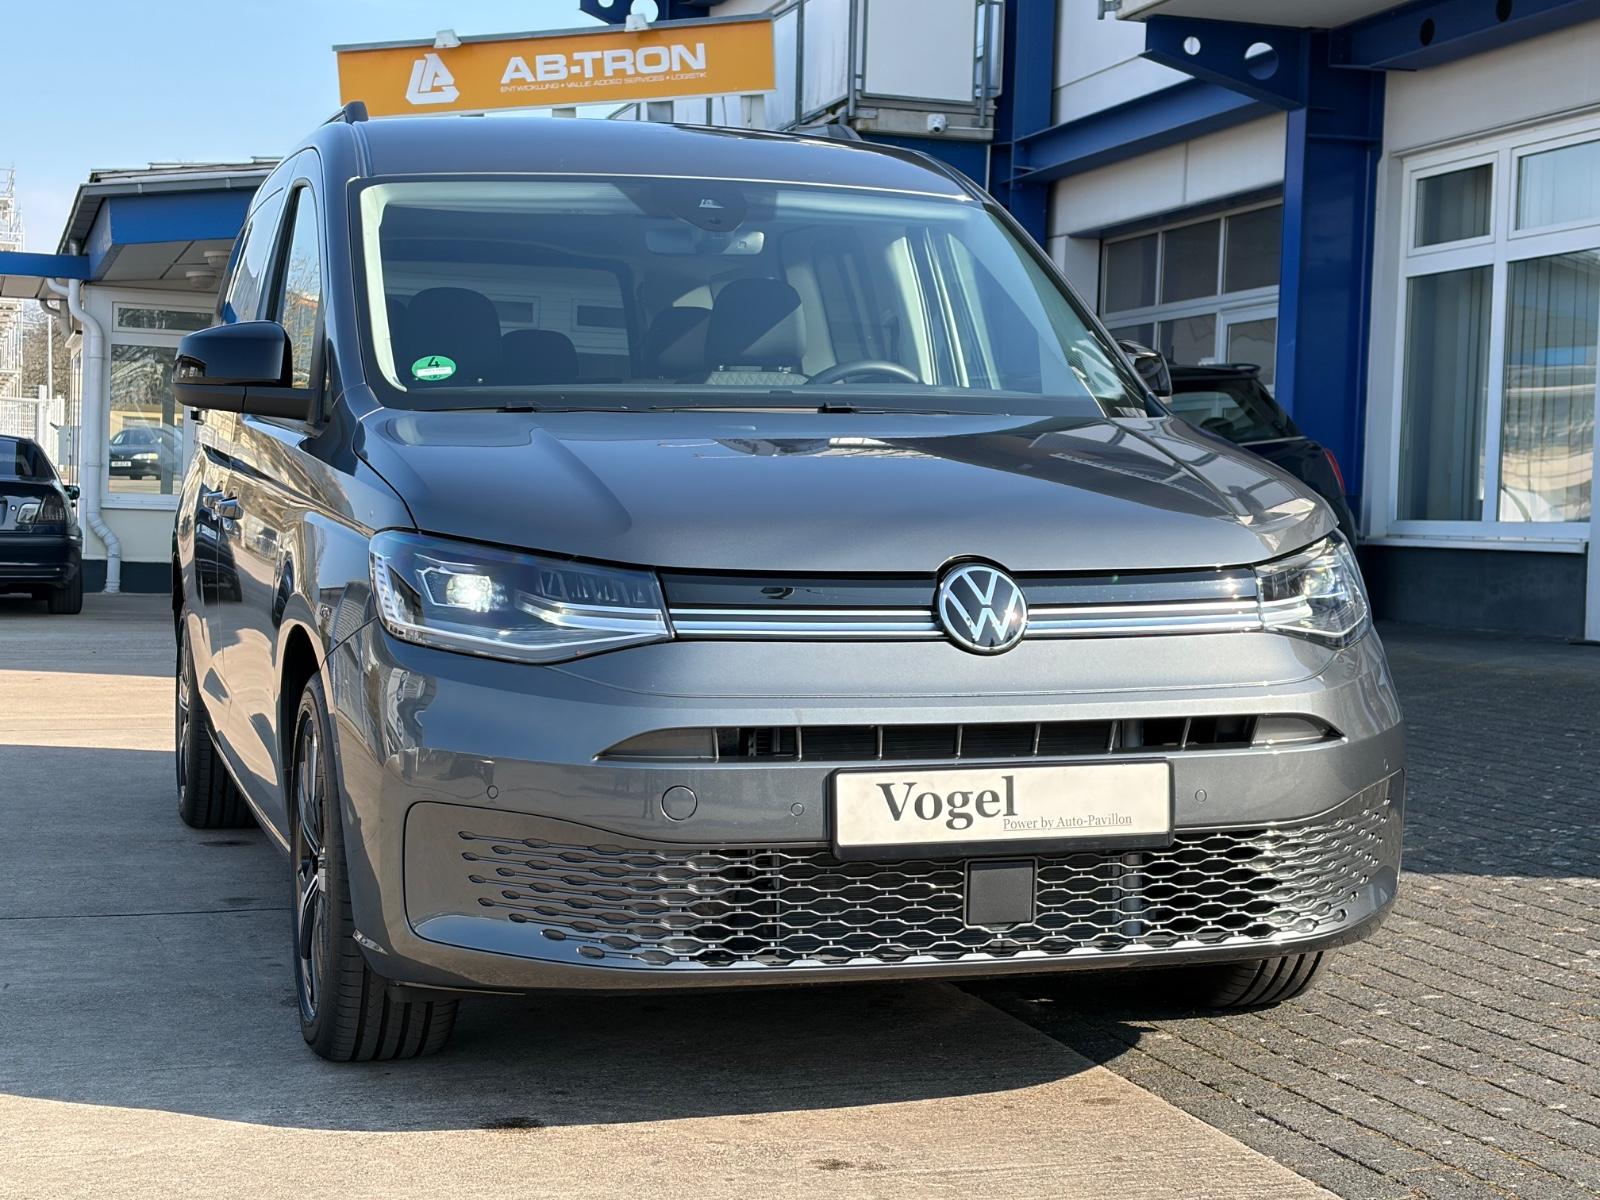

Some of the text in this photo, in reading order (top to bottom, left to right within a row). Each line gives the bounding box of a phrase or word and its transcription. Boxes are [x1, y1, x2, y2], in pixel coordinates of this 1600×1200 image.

[501, 42, 706, 85] AB-TRON
[428, 356, 440, 368] 4
[876, 775, 1018, 831] Vogel
[1003, 812, 1132, 830] Power by Auto-Pavillon
